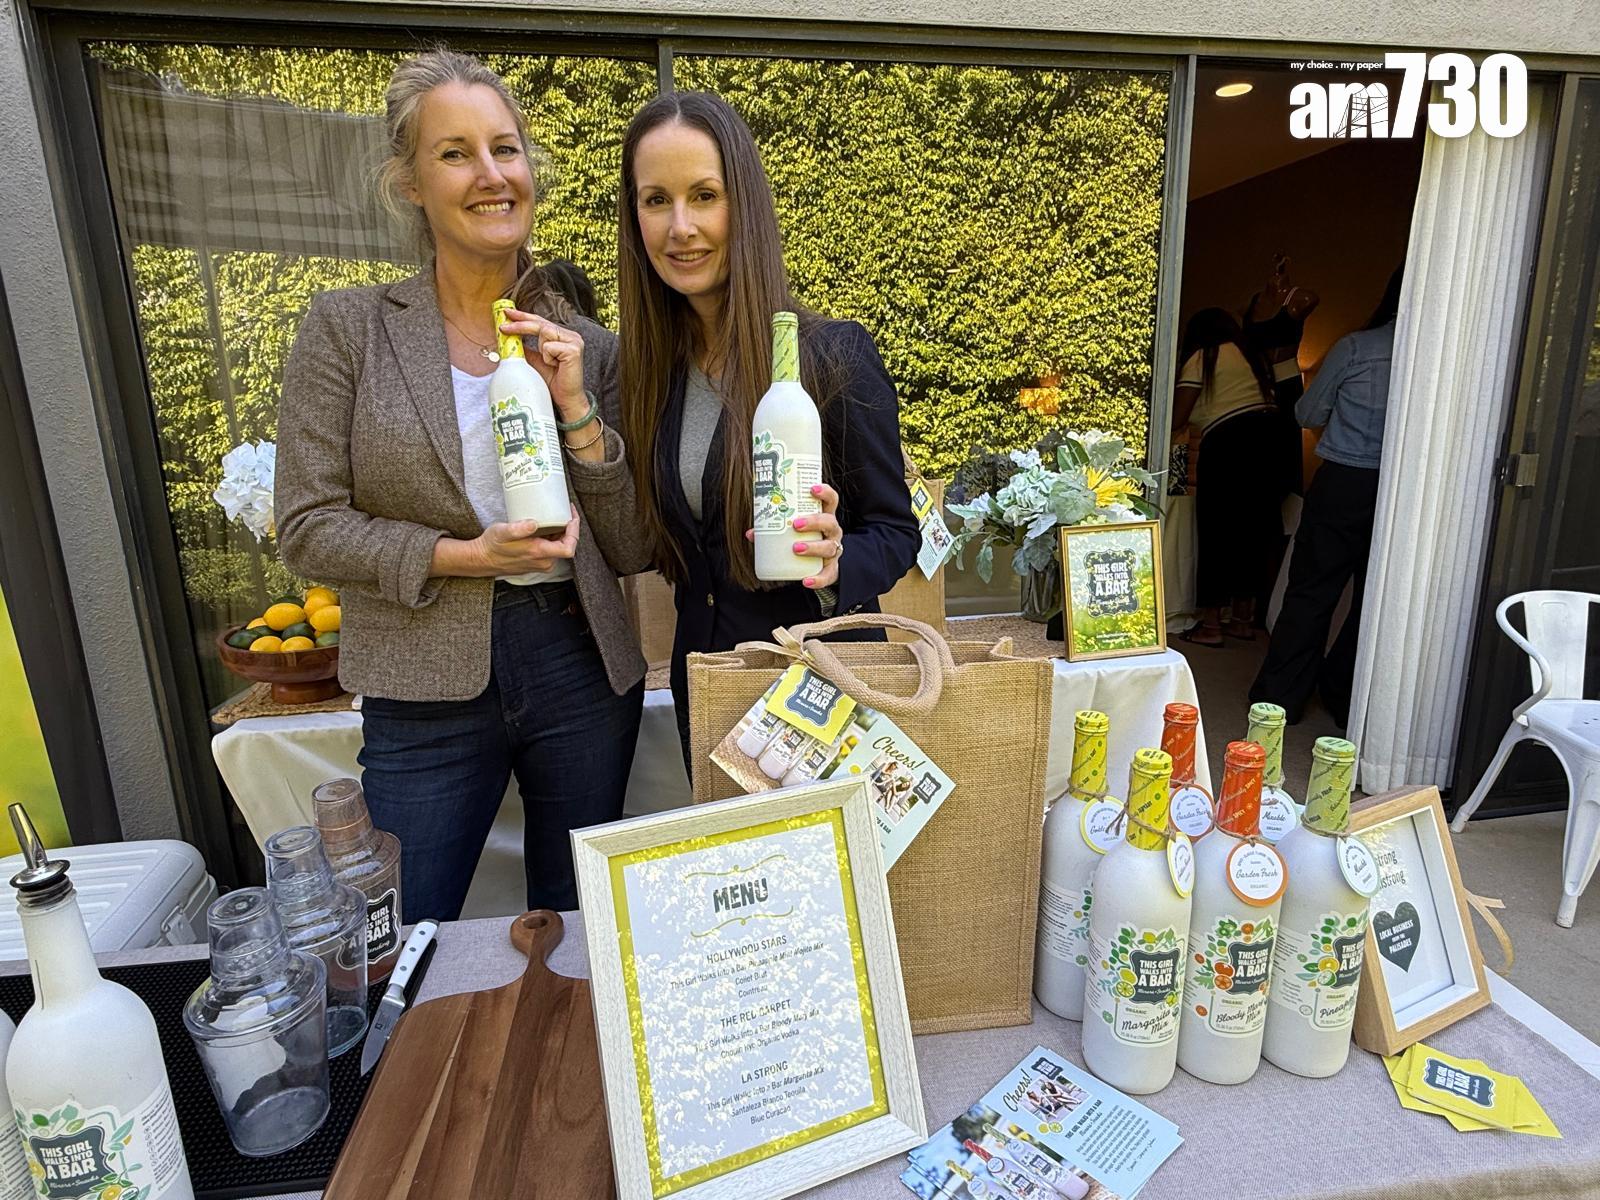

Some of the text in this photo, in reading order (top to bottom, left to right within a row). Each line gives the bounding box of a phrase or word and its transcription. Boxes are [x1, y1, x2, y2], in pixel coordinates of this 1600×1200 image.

[1093, 561, 1128, 574] THIS GIRL
[1094, 578, 1131, 597] A BAR
[808, 675, 837, 696] THIS GIRL
[799, 687, 810, 700] A
[806, 691, 830, 710] BAR
[872, 736, 927, 771] Cheers!
[1377, 850, 1398, 867] trong
[1236, 867, 1278, 879] Garden Fresh
[713, 877, 769, 913] MENU
[370, 904, 390, 922] GIRL
[374, 914, 390, 928] INTO
[1379, 919, 1414, 941] LOCAL BUSINESS
[706, 934, 787, 964] HOLLYWOOD STARS
[1238, 951, 1256, 960] THIS
[1342, 943, 1357, 953] THIS
[1140, 958, 1174, 969] THIS GIRL
[1160, 966, 1173, 975] INTO
[1235, 963, 1267, 978] A BAR
[1237, 958, 1257, 966] WALKS
[1340, 958, 1348, 971] A
[1137, 973, 1172, 987] A BAR
[719, 1014, 739, 1029] THE
[759, 999, 791, 1017] CARPET
[1121, 1009, 1171, 1031] Margarita
[1215, 1009, 1246, 1023] Bloody
[1150, 1021, 1169, 1035] Mix
[741, 1060, 789, 1084] LA STRONG
[1453, 1072, 1471, 1090] BAR
[707, 1102, 723, 1112] This
[771, 1080, 783, 1090] Bar
[1002, 1067, 1033, 1113] Cheers!
[40, 1140, 93, 1158] THIS GIRL
[43, 1150, 94, 1166] WALKS INTO
[46, 1157, 98, 1180] A BAR
